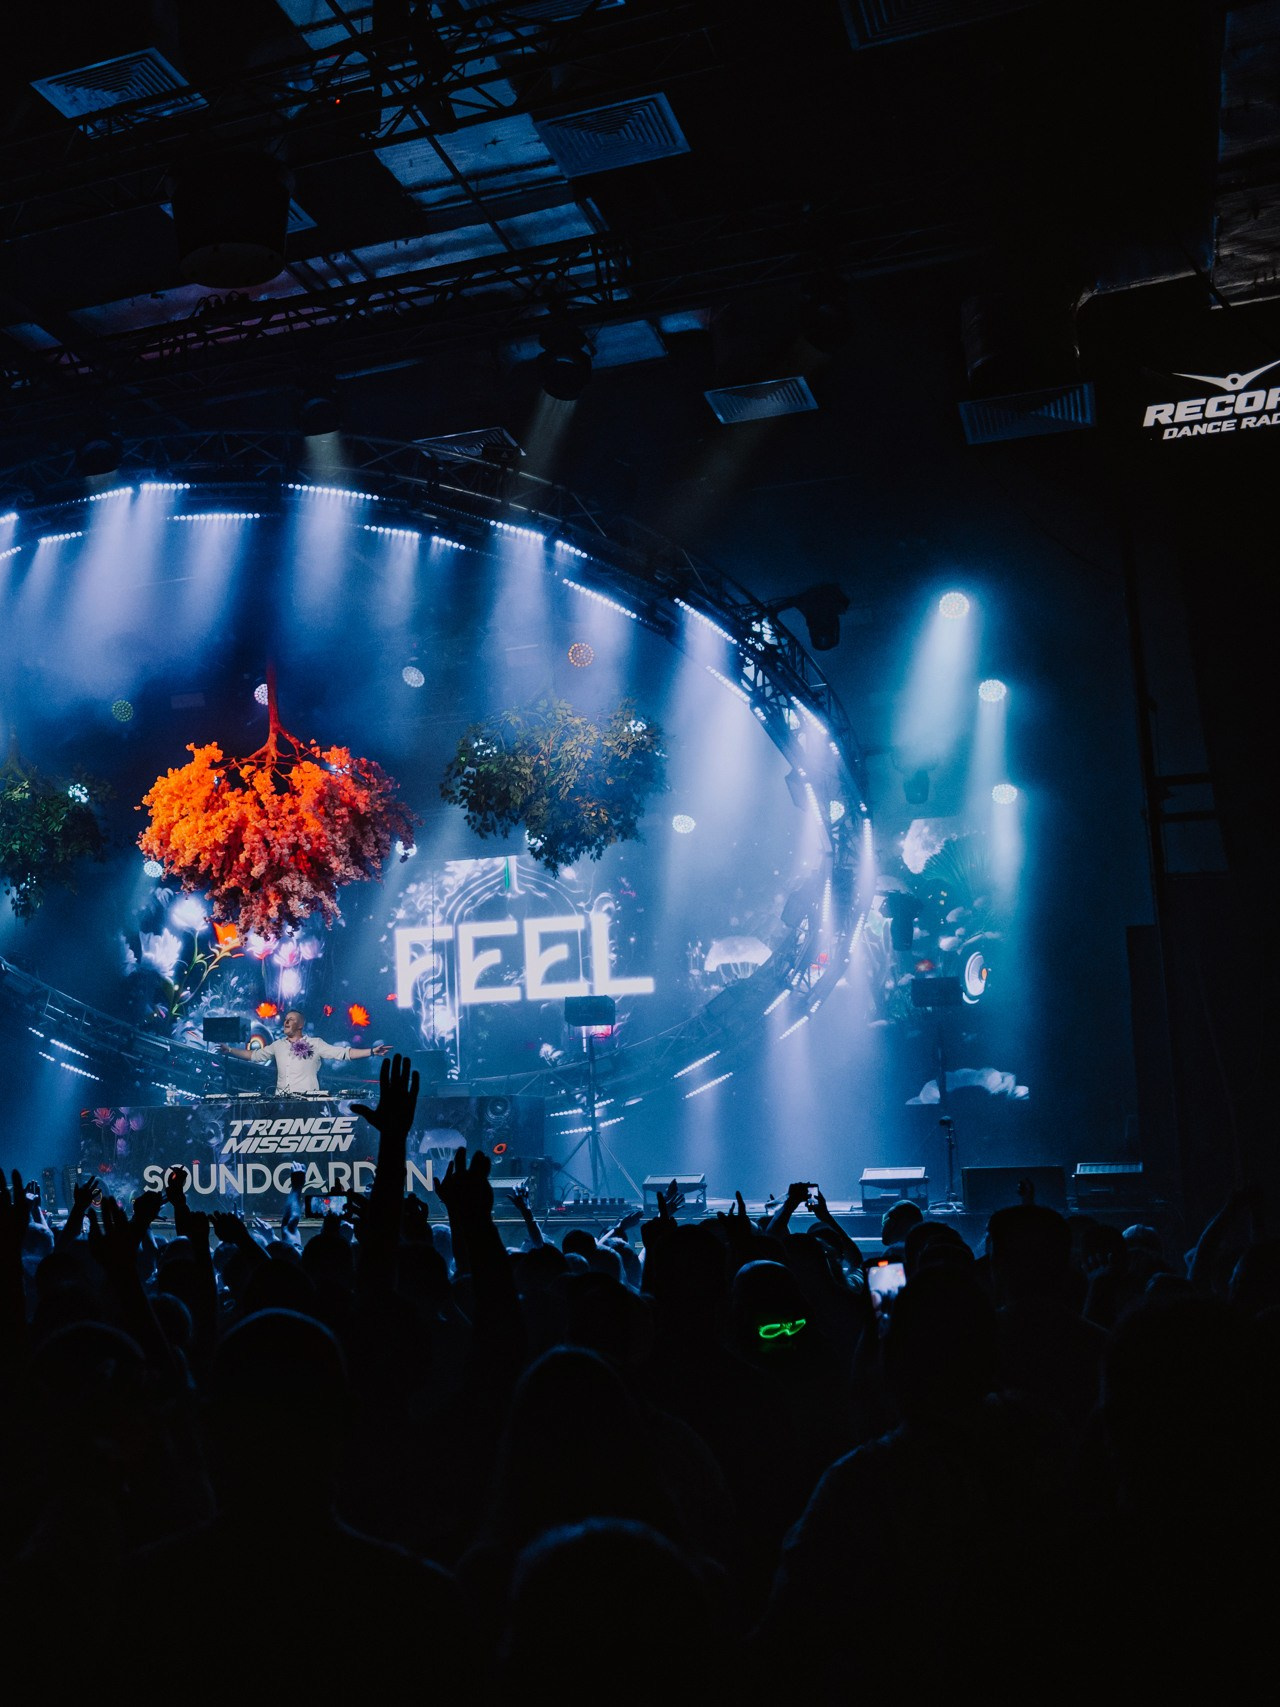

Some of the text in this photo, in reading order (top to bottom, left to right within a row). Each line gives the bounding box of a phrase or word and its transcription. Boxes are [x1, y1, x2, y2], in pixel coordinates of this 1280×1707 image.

[1162, 419, 1238, 440] DANCE
[395, 912, 655, 1008] FEEL
[229, 1116, 358, 1137] TRANCE
[220, 1134, 355, 1154] MISSION
[142, 1160, 433, 1195] SOUNDGARDN
